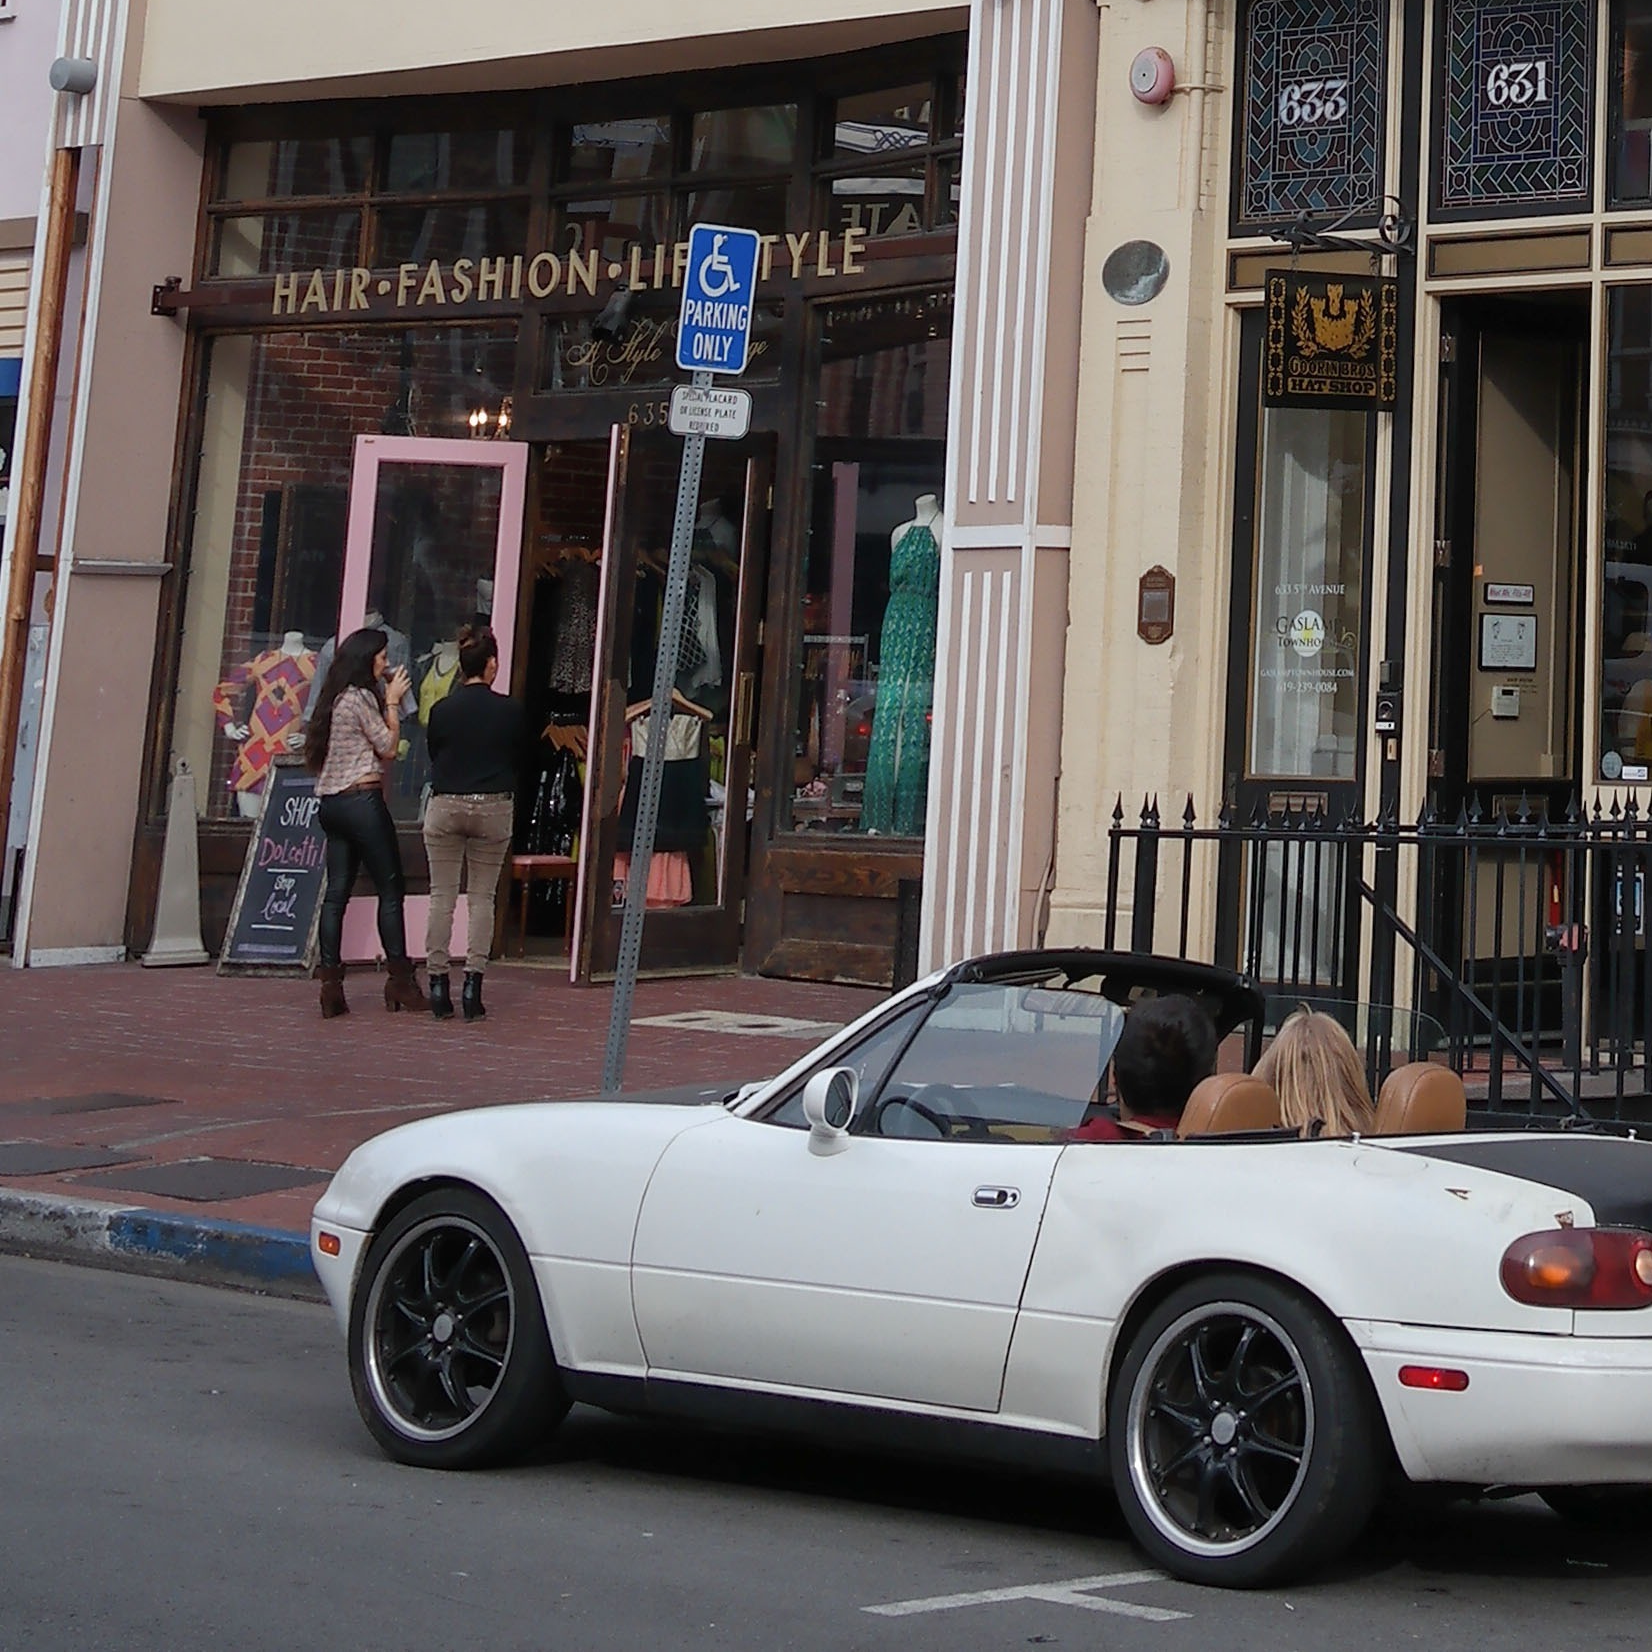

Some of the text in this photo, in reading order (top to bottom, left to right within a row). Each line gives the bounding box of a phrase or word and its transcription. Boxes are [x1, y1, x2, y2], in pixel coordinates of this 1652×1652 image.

[1486, 60, 1550, 107] 631
[1279, 79, 1348, 126] 633
[271, 227, 868, 316] HAIR FASHION LIFTYLE
[684, 299, 748, 332] PARKING
[692, 332, 734, 363] ONLY
[1288, 356, 1339, 377] GOORIN
[1291, 378, 1376, 394] HAT SHOP
[628, 402, 669, 425] 635
[714, 408, 737, 420] PLATE
[1309, 584, 1345, 595] AVENUE
[1277, 636, 1338, 649] TOWNHO
[280, 797, 321, 829] SHOP
